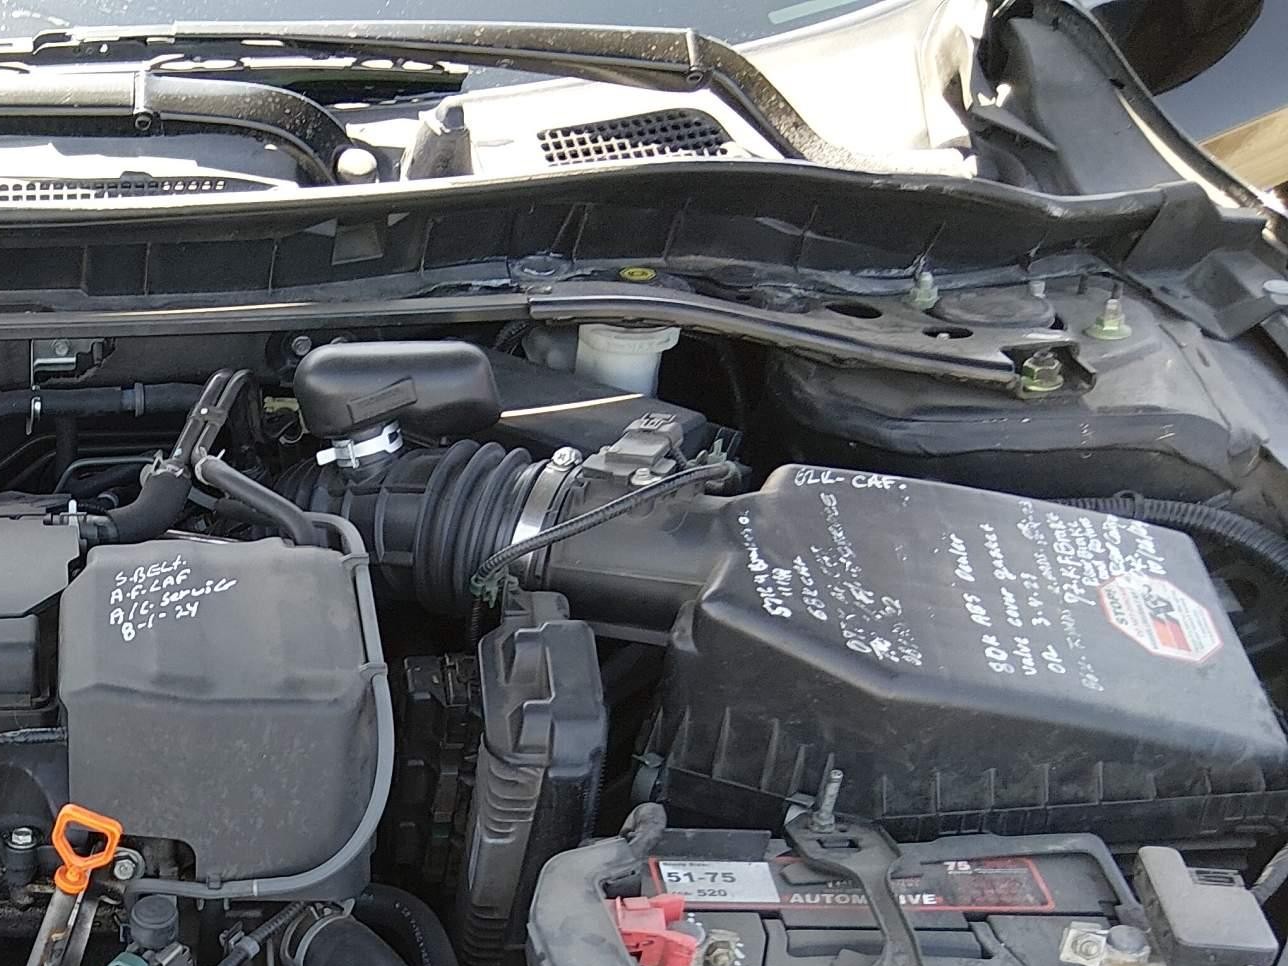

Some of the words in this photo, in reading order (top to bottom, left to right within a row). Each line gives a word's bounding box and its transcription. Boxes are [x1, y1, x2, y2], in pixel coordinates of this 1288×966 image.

[667, 871, 736, 883] 51-75
[697, 889, 727, 898] 520
[789, 892, 937, 905] AUTOMIVE
